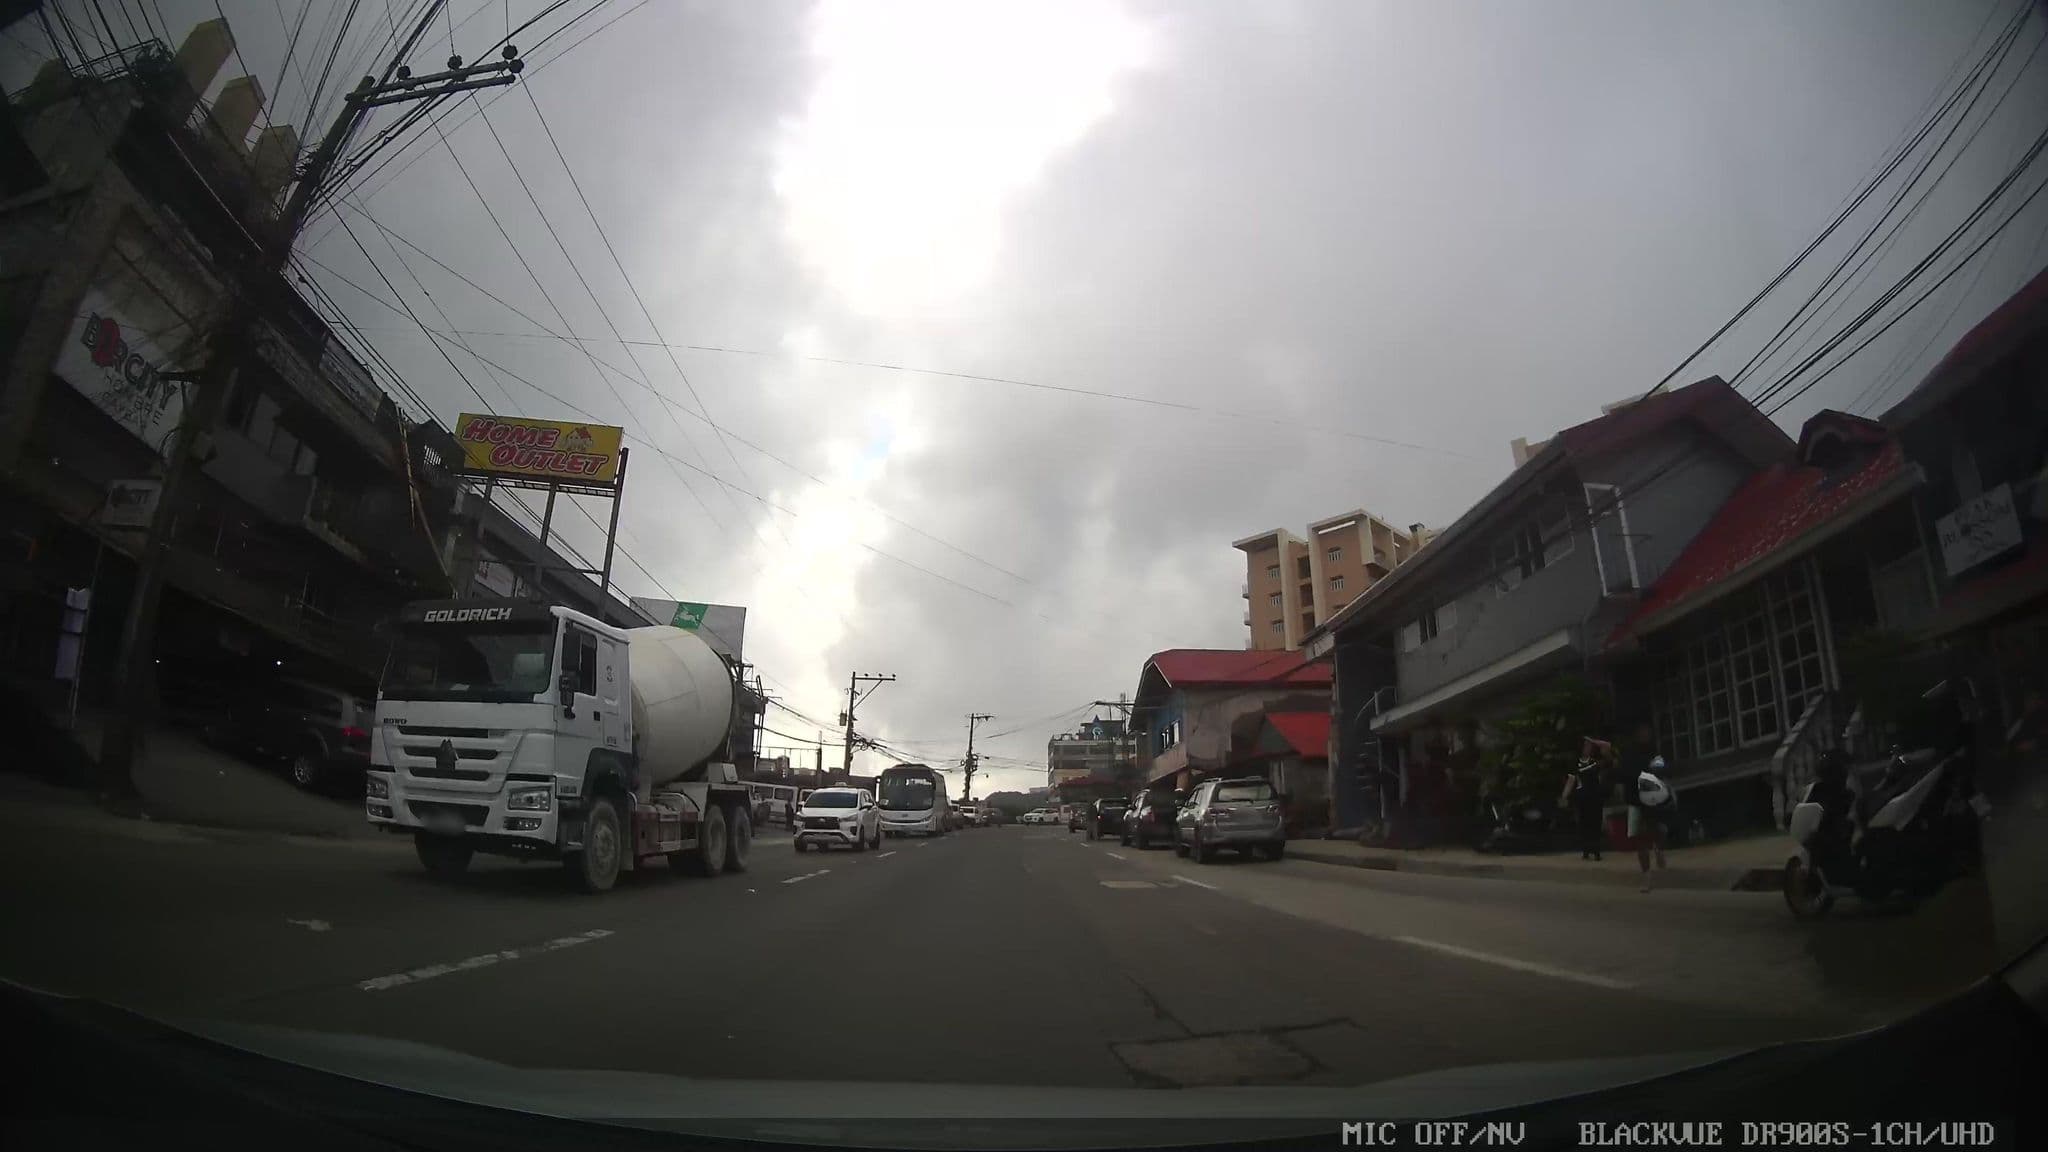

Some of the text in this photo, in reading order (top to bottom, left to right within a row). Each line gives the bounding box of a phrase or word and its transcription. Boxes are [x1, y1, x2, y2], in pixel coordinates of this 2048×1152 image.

[463, 418, 560, 449] HOME
[490, 444, 609, 475] OUTLET
[424, 607, 513, 623] GOLDRICH
